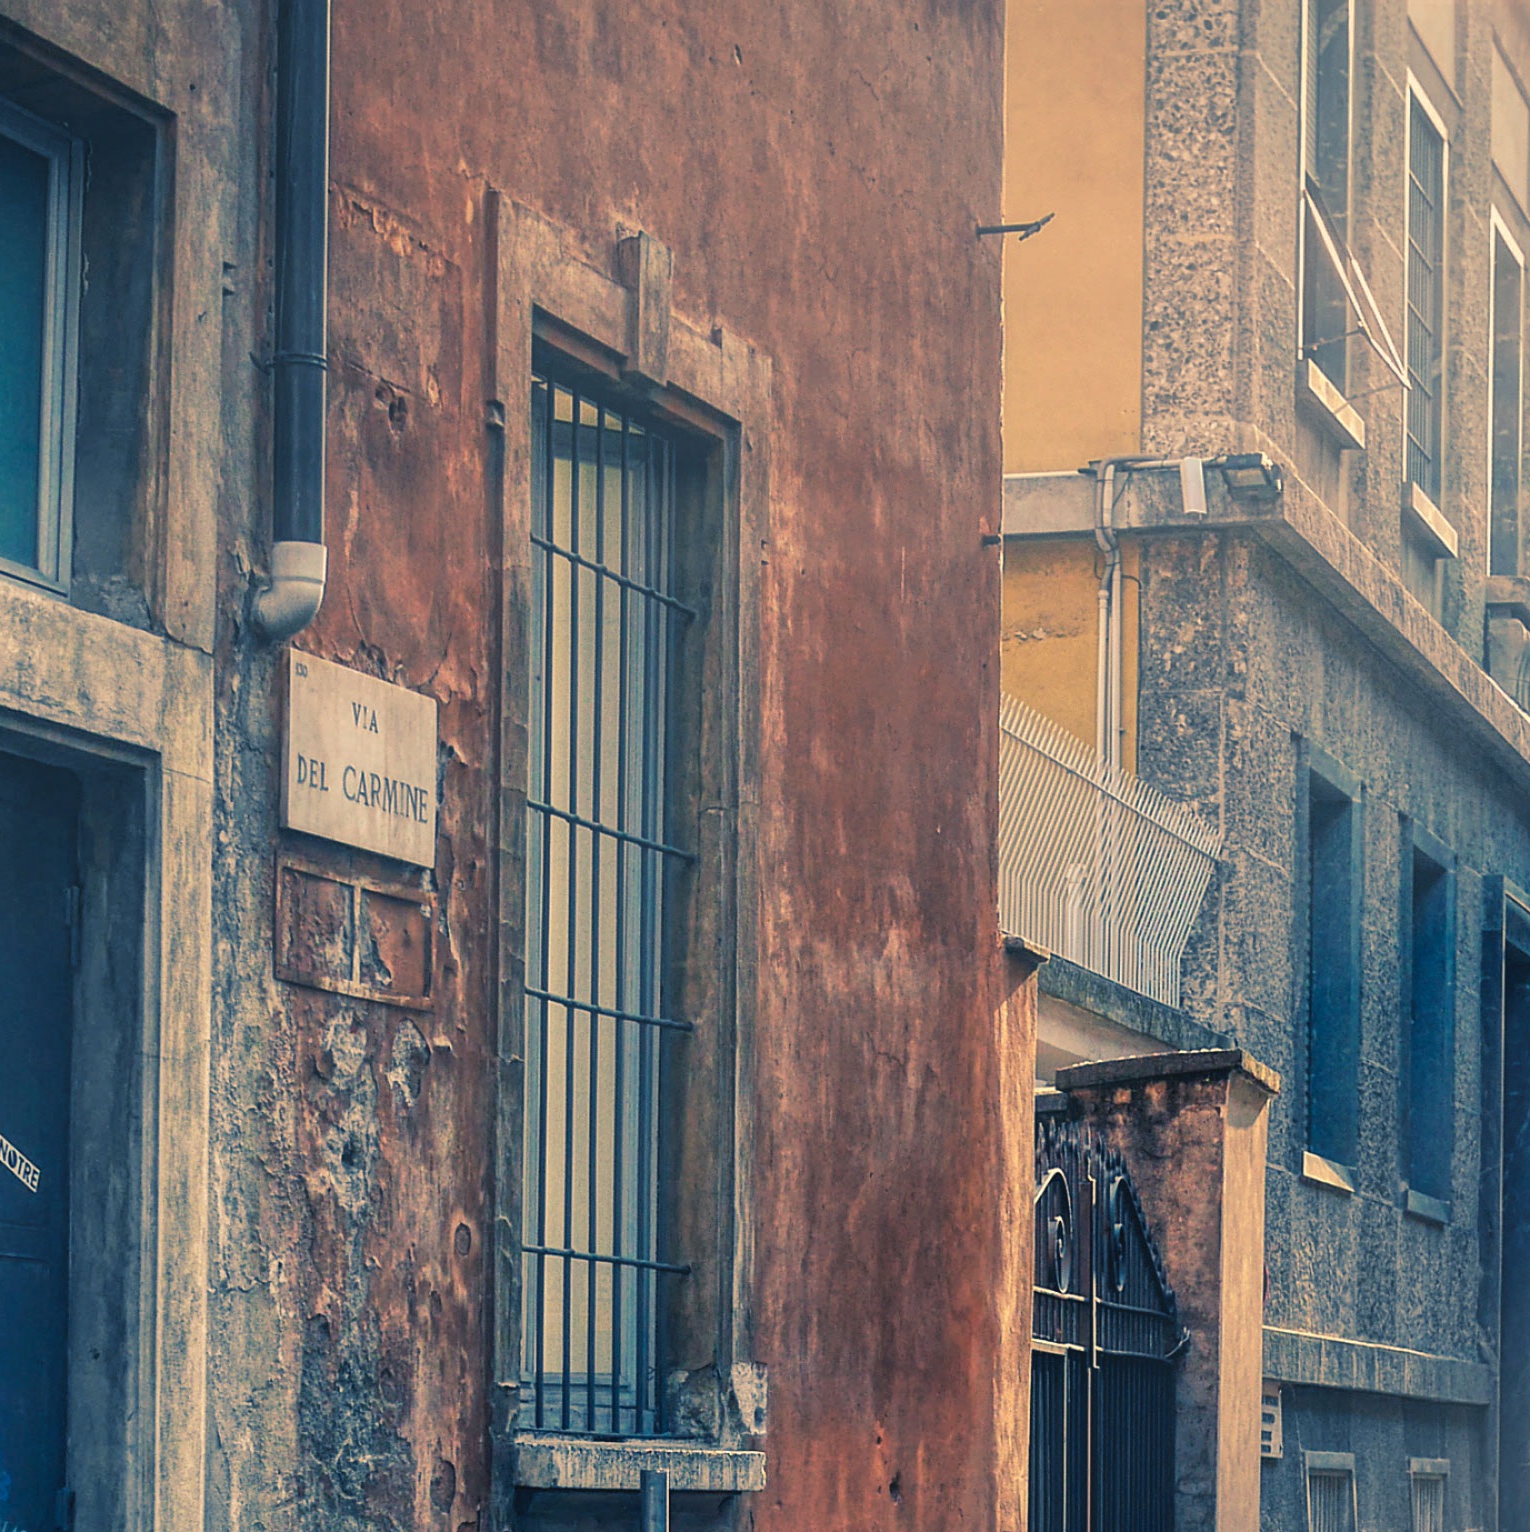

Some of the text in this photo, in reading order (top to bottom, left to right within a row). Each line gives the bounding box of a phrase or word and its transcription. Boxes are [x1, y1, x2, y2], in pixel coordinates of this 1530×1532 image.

[352, 702, 379, 734] VIA
[297, 753, 429, 824] DEL CARMINE
